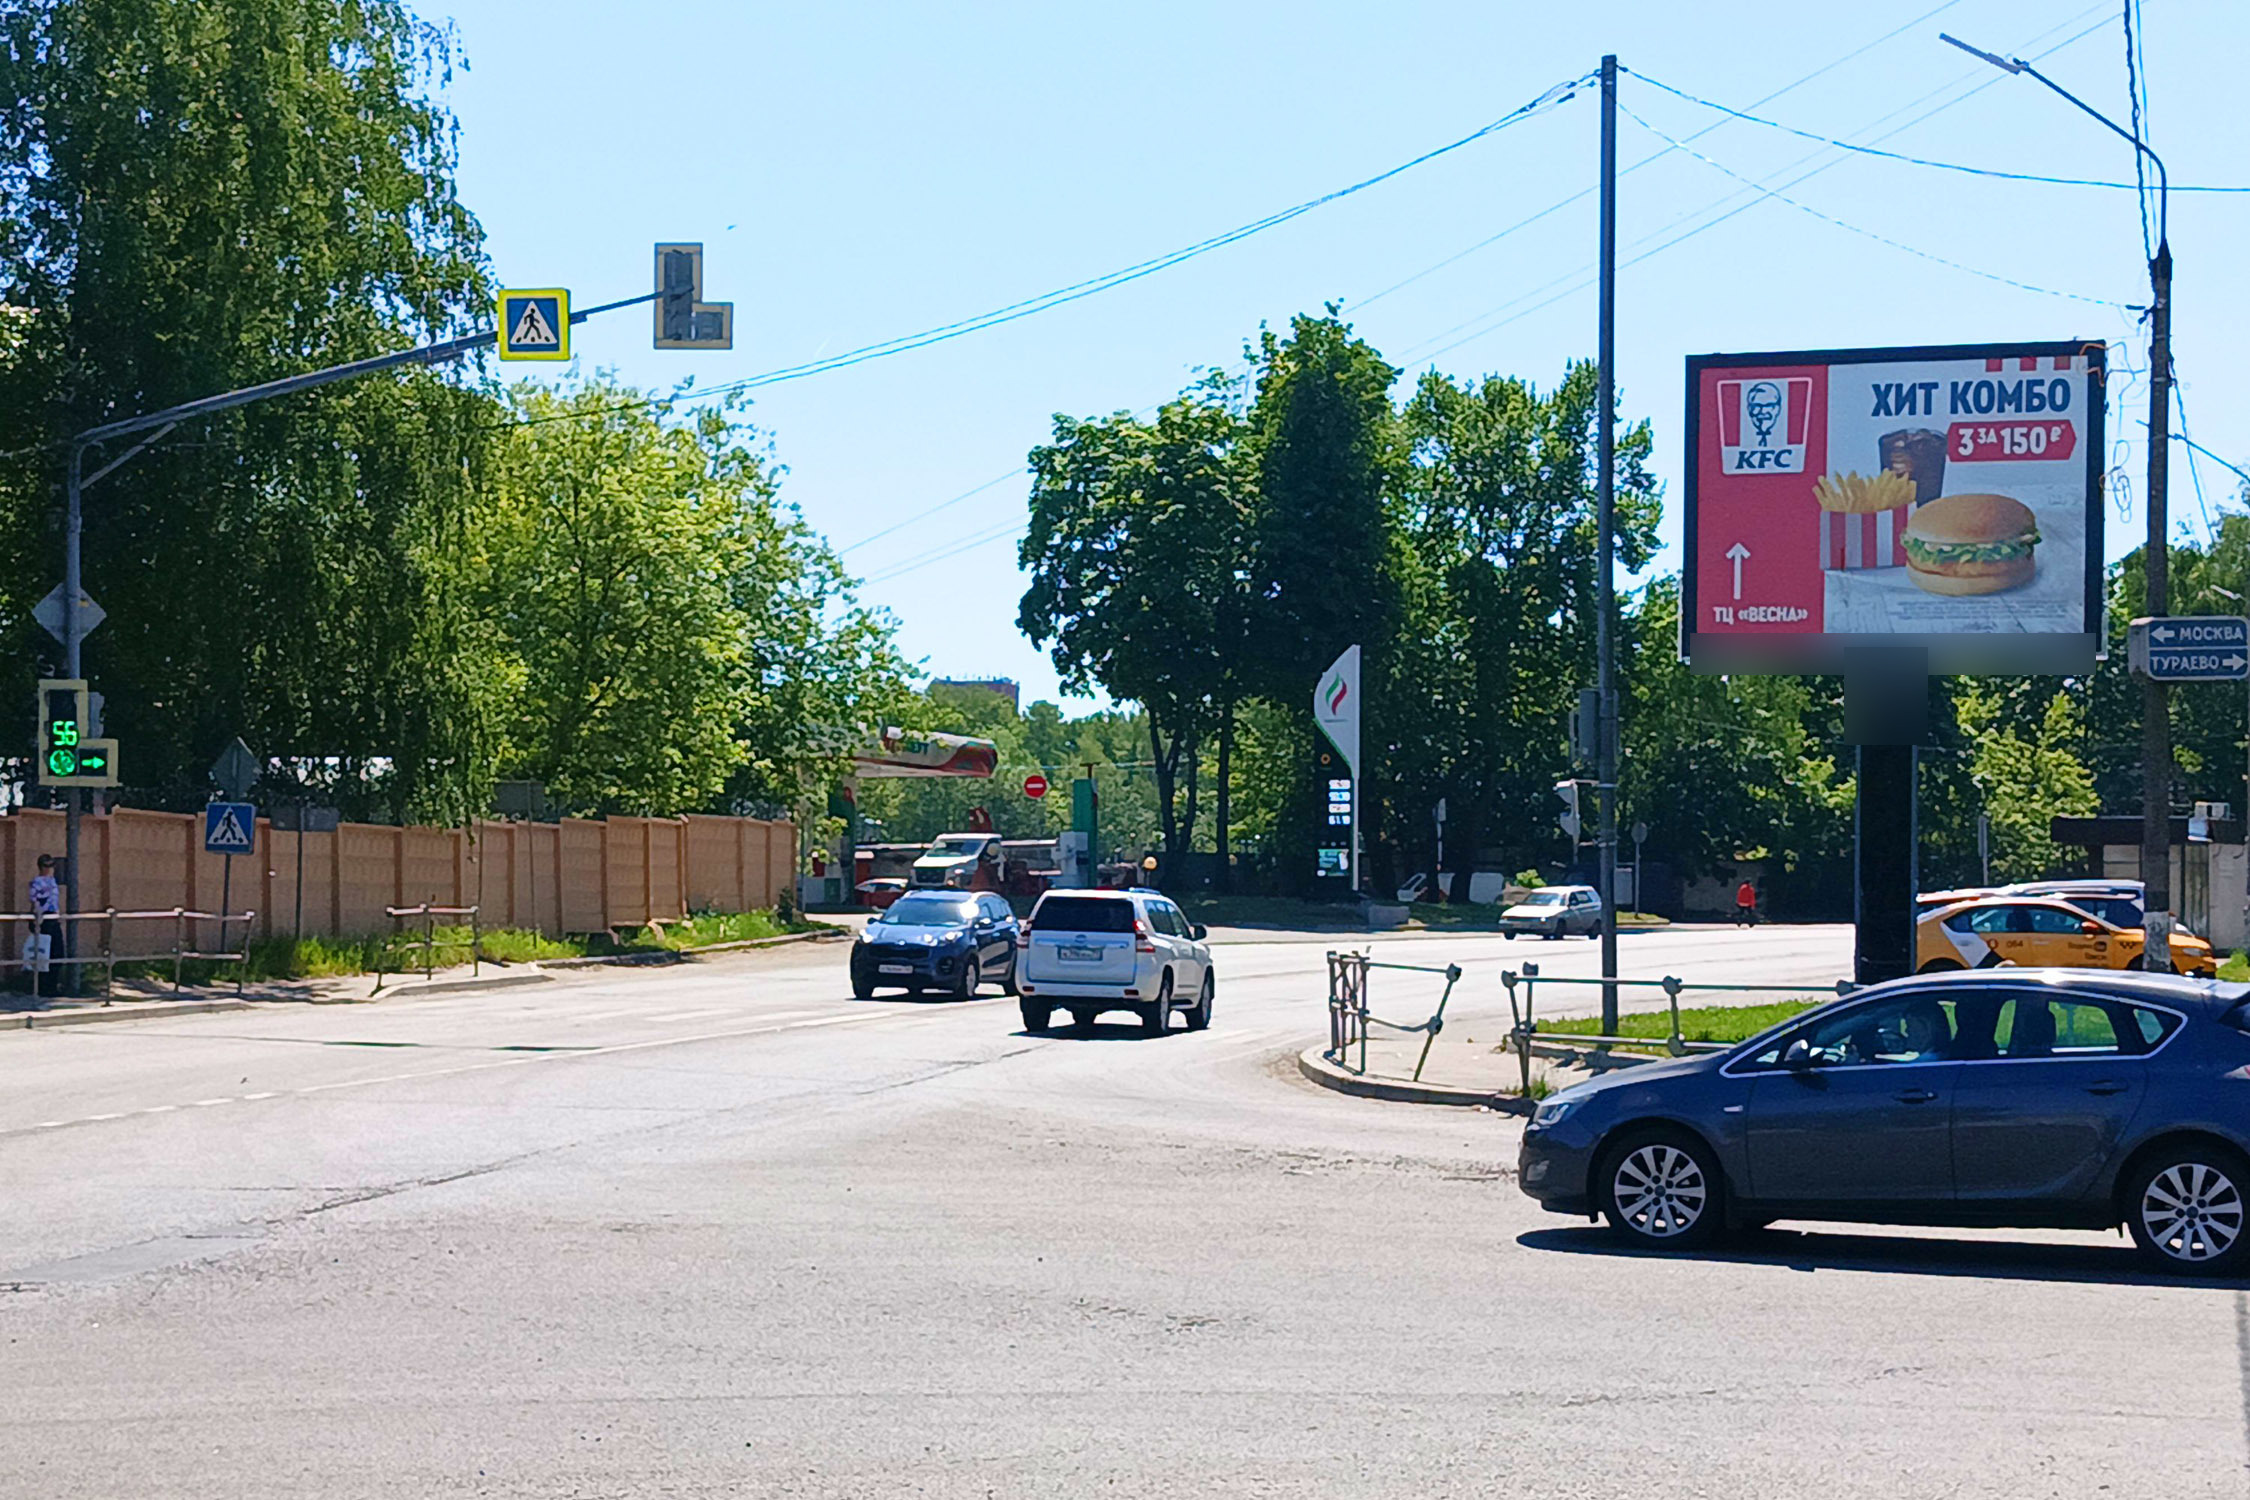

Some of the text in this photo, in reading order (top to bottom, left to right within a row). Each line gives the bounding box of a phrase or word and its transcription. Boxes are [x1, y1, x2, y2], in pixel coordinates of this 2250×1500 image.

[1871, 378, 2071, 416] ХИТ КОМБО
[1958, 428, 1974, 456] 3
[2000, 426, 2047, 455] 150
[1735, 449, 1792, 469] KFC
[1712, 606, 1808, 625] ТЦ «ВЕСНА»
[2179, 626, 2244, 641] МОСКВА
[2151, 655, 2219, 671] ТУРАЕВО
[53, 720, 77, 746] 56
